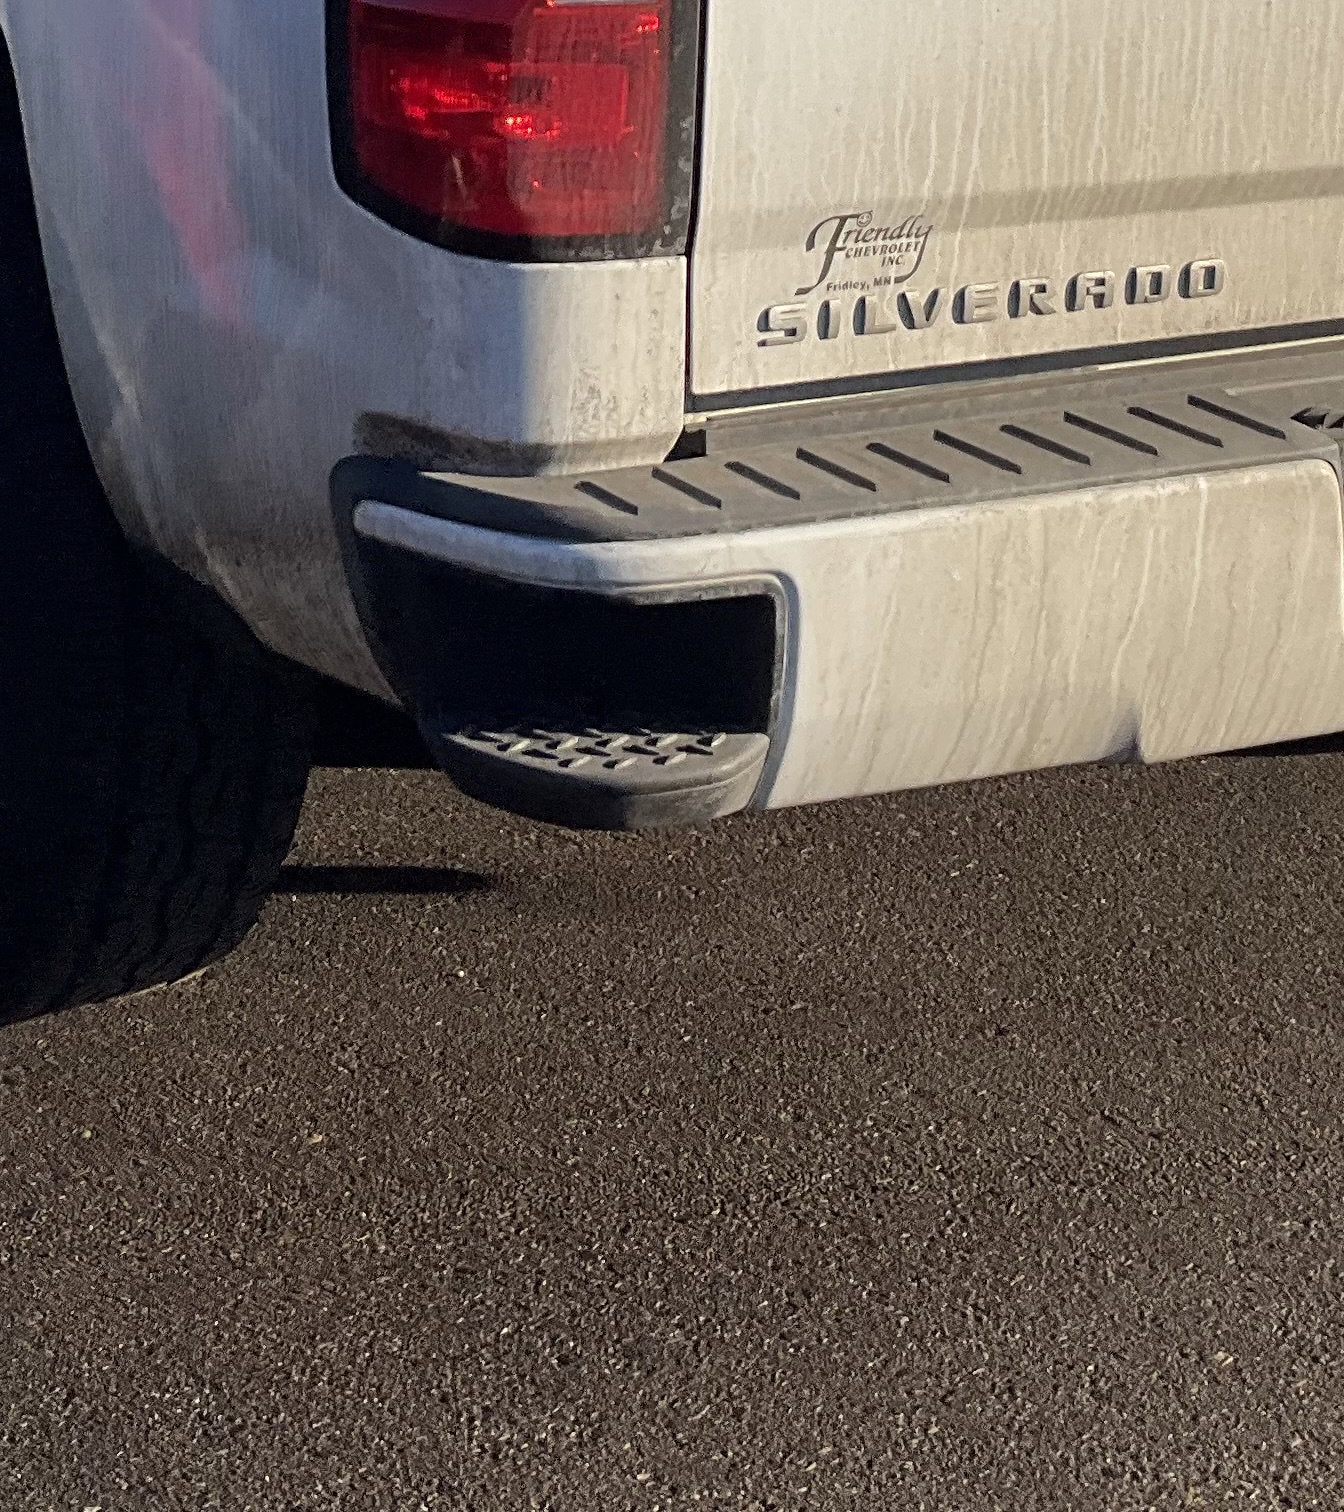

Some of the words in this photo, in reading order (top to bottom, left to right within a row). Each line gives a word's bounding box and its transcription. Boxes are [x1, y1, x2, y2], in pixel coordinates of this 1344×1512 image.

[794, 210, 934, 296] Friendly
[844, 240, 922, 259] CHEVROLET
[757, 257, 1226, 347] SILVERADO
[826, 280, 870, 292] Fridley,
[873, 276, 891, 287] MN
